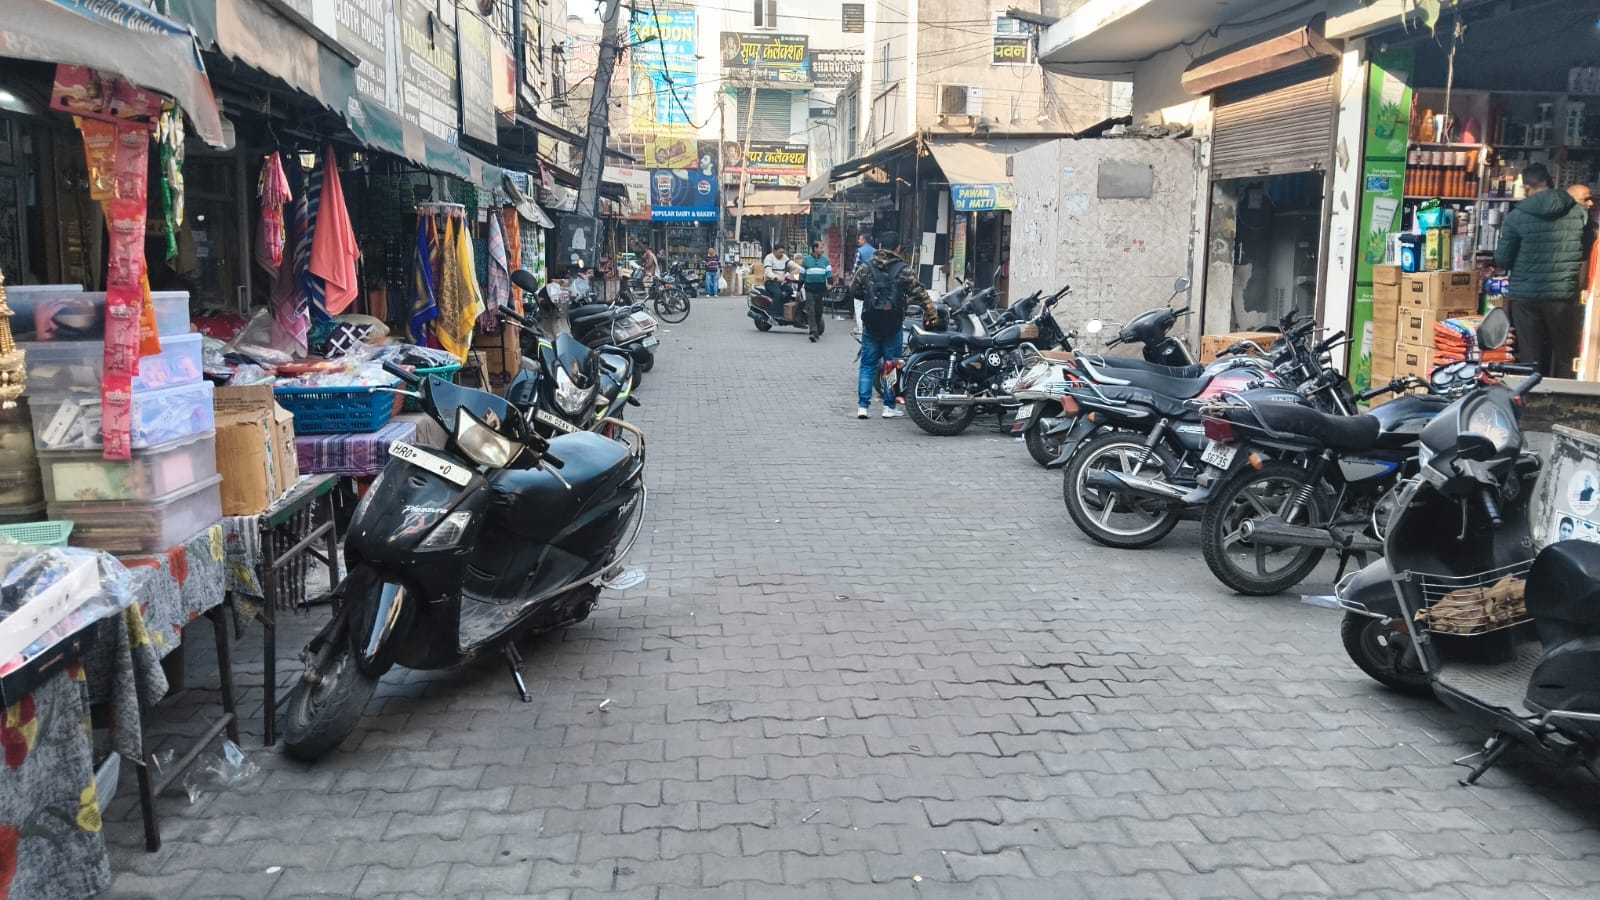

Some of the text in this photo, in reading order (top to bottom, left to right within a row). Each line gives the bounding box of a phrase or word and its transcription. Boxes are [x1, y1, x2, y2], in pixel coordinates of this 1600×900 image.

[360, 14, 385, 51] HOUSE
[959, 189, 989, 198] PAWAN
[956, 199, 995, 209] DI HATTI
